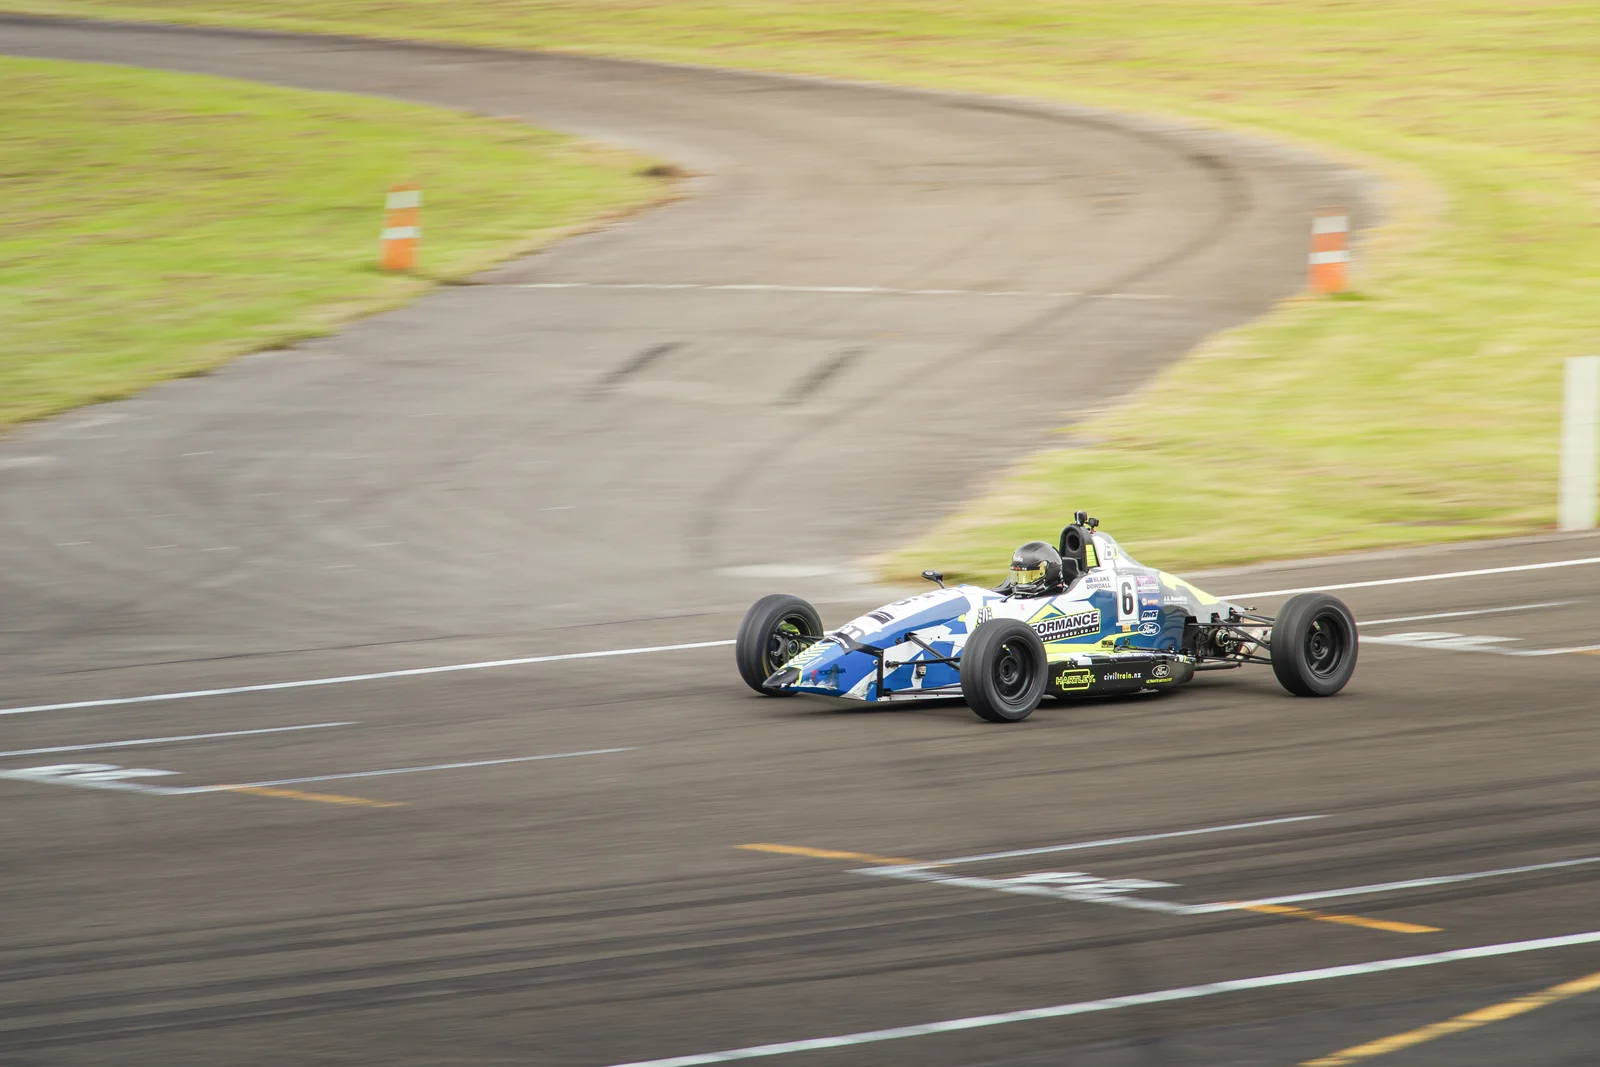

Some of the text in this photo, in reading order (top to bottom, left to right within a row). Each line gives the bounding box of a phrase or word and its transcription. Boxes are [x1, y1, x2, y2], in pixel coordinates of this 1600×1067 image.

[1086, 582, 1112, 590] DOWDALL
[1121, 581, 1134, 615] 6
[1103, 672, 1142, 681] civiltrain.nz
